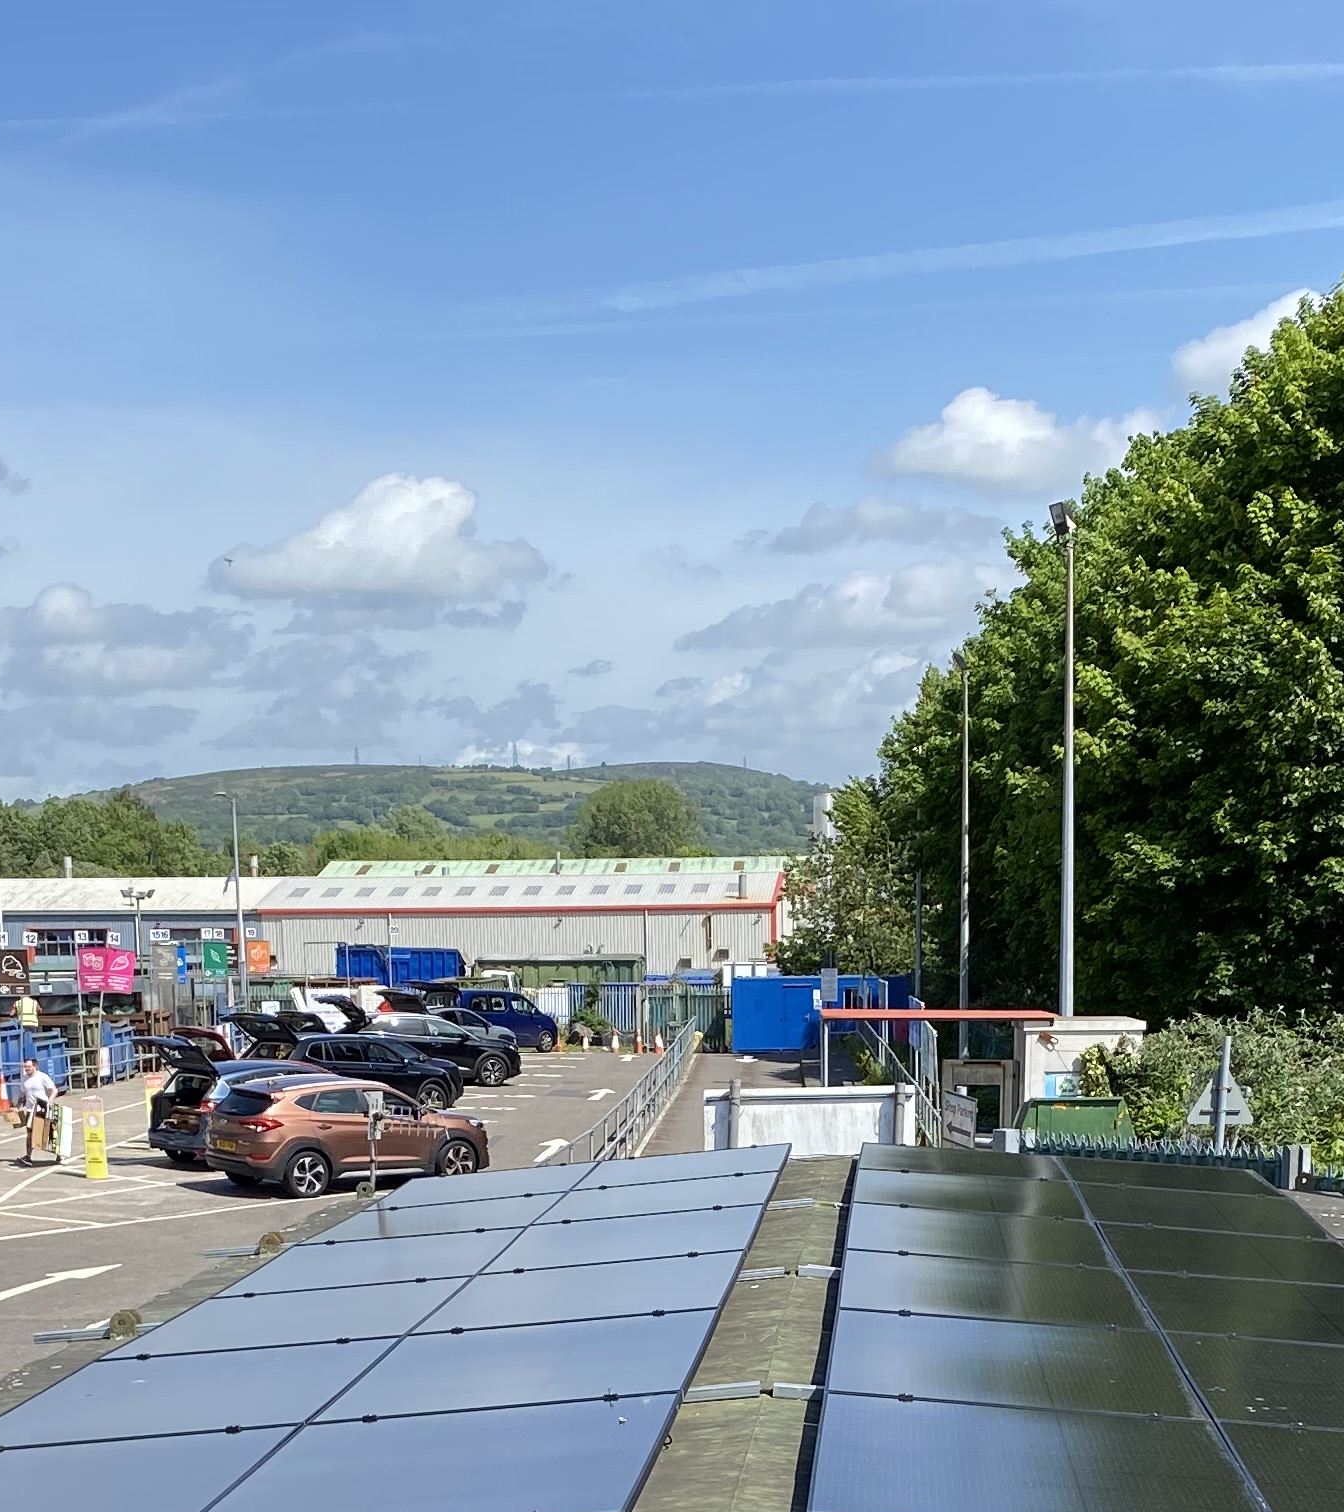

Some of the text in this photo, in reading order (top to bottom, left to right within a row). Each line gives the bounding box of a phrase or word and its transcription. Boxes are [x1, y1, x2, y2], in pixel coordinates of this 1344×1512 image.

[25, 933, 36, 943] 12
[77, 932, 86, 941] 13
[109, 933, 119, 943] 14
[945, 1099, 974, 1122] Shop Parking
